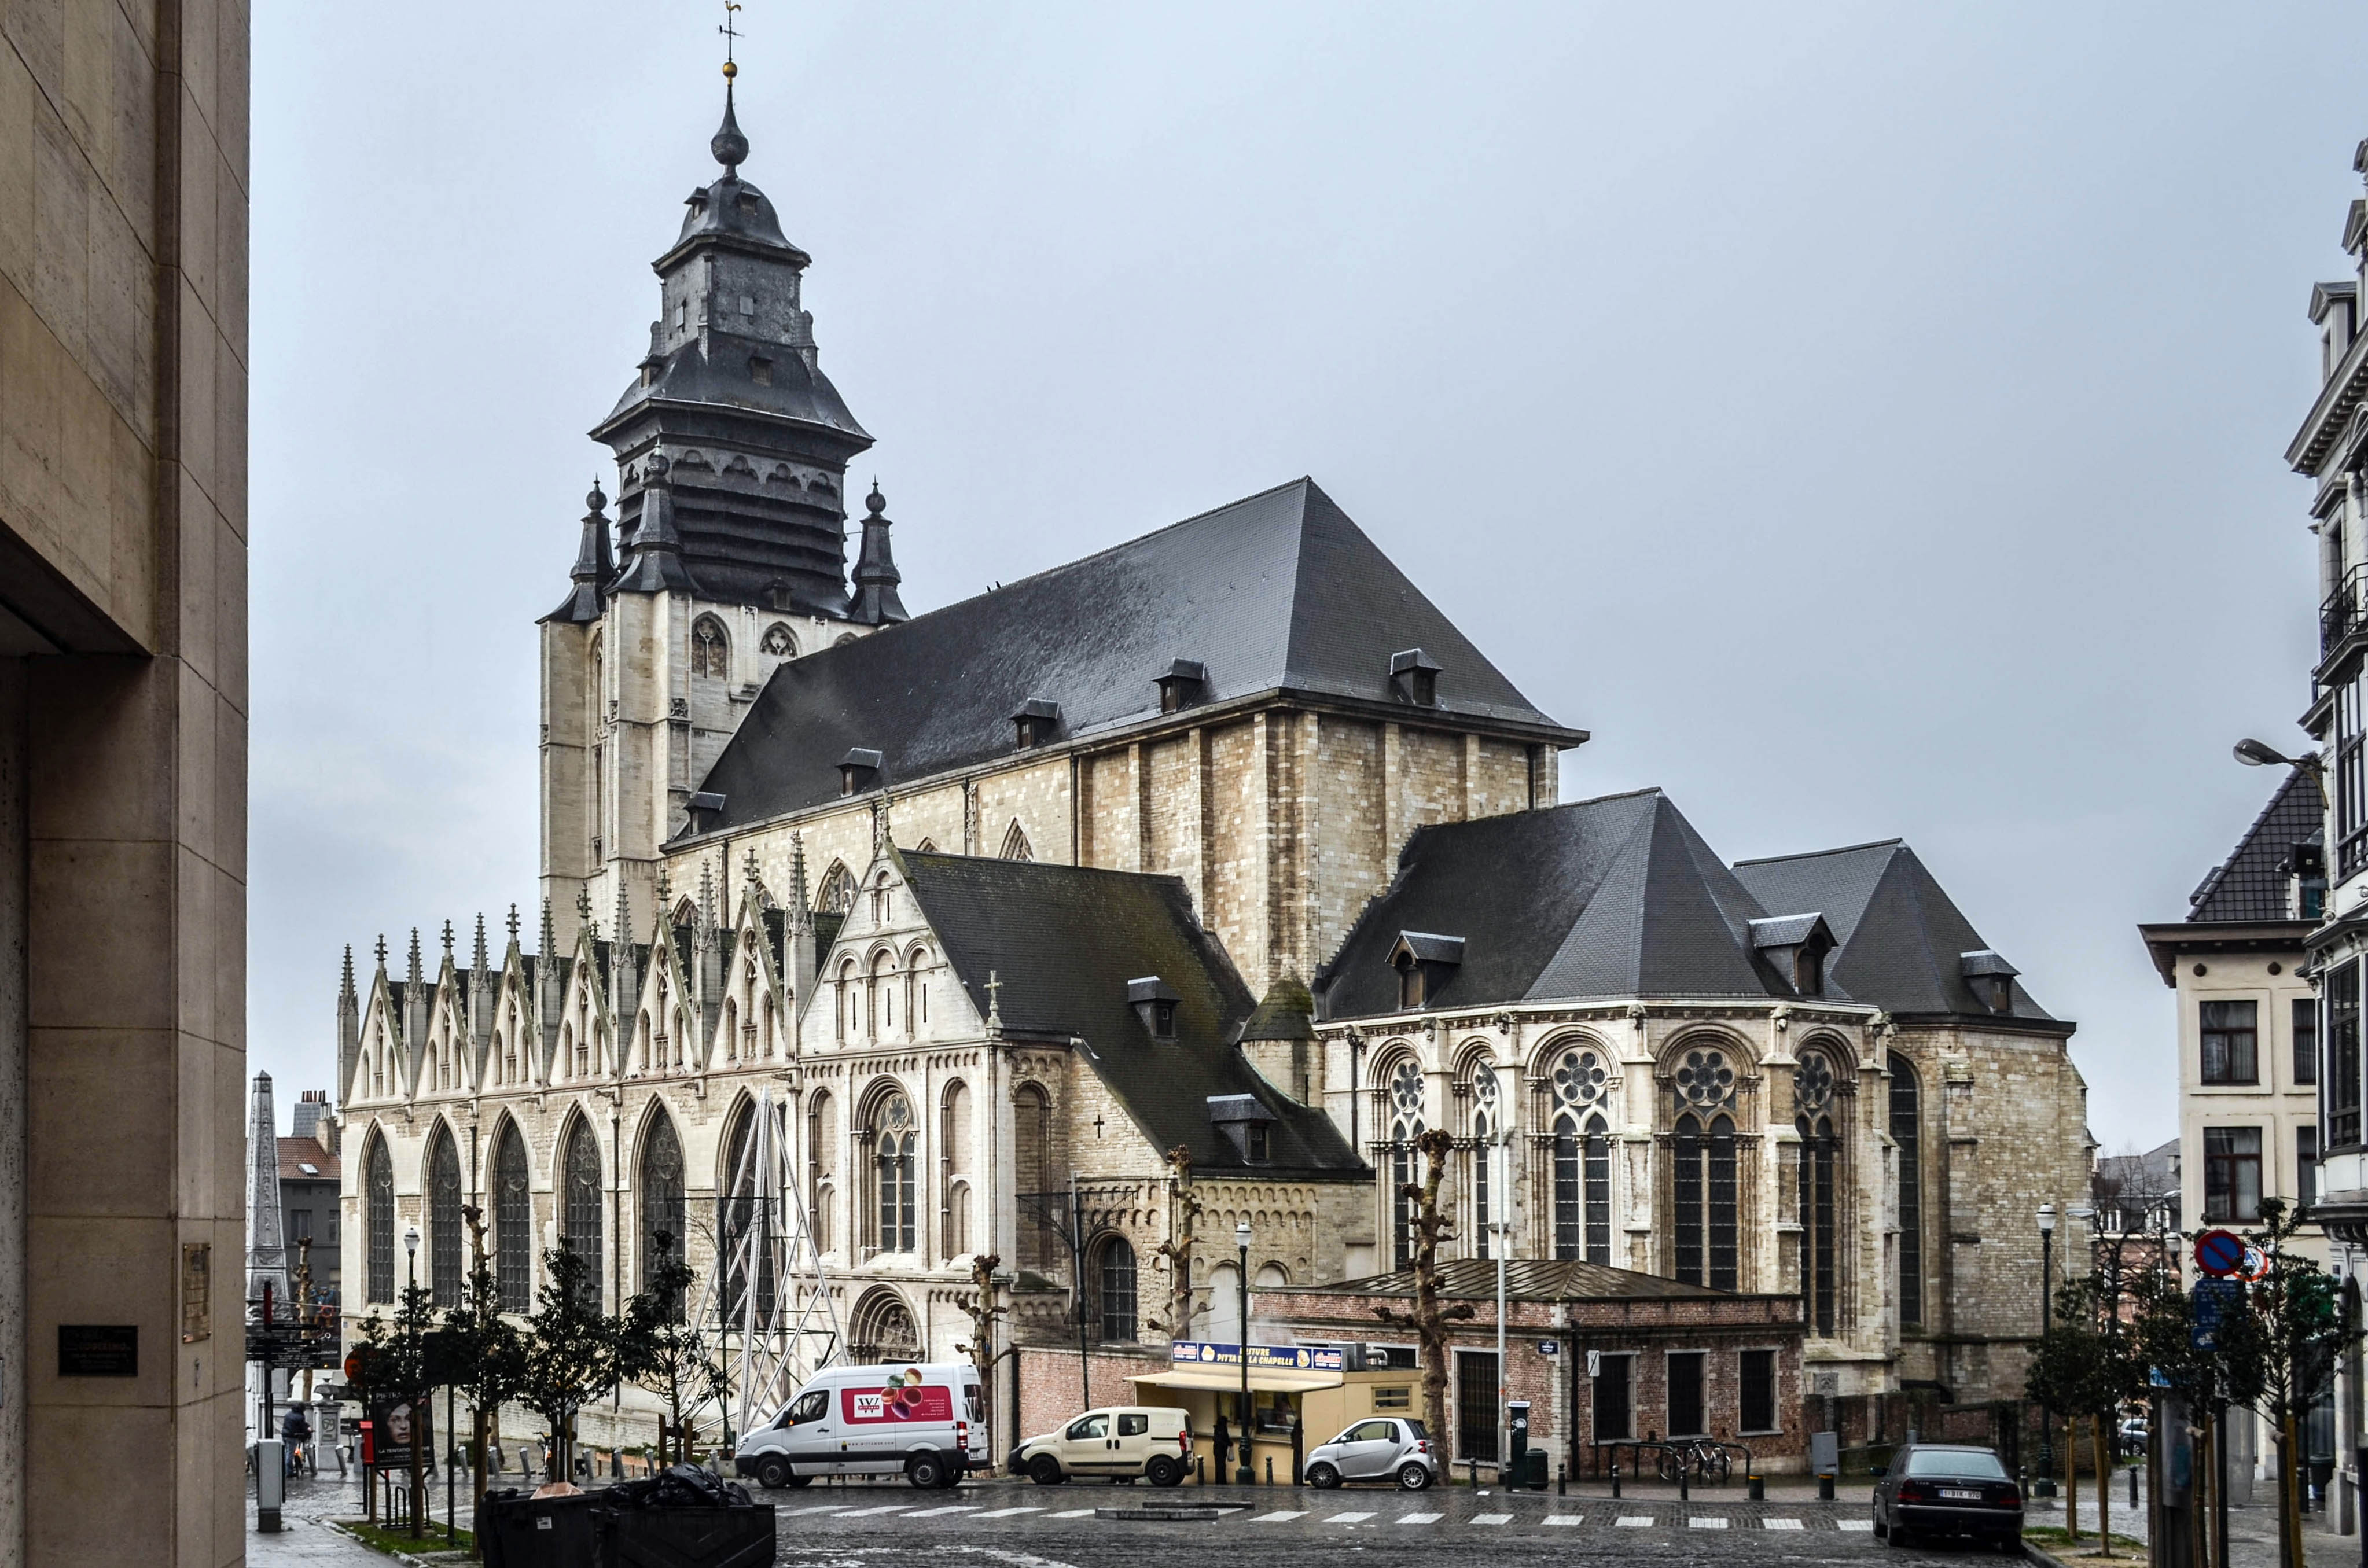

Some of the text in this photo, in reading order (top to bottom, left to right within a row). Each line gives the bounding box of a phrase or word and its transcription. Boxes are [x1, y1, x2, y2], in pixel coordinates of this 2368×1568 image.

[1217, 1354, 1237, 1363] PITTA
[1249, 1356, 1257, 1364] LA
[1259, 1357, 1295, 1366] CHAPELLE
